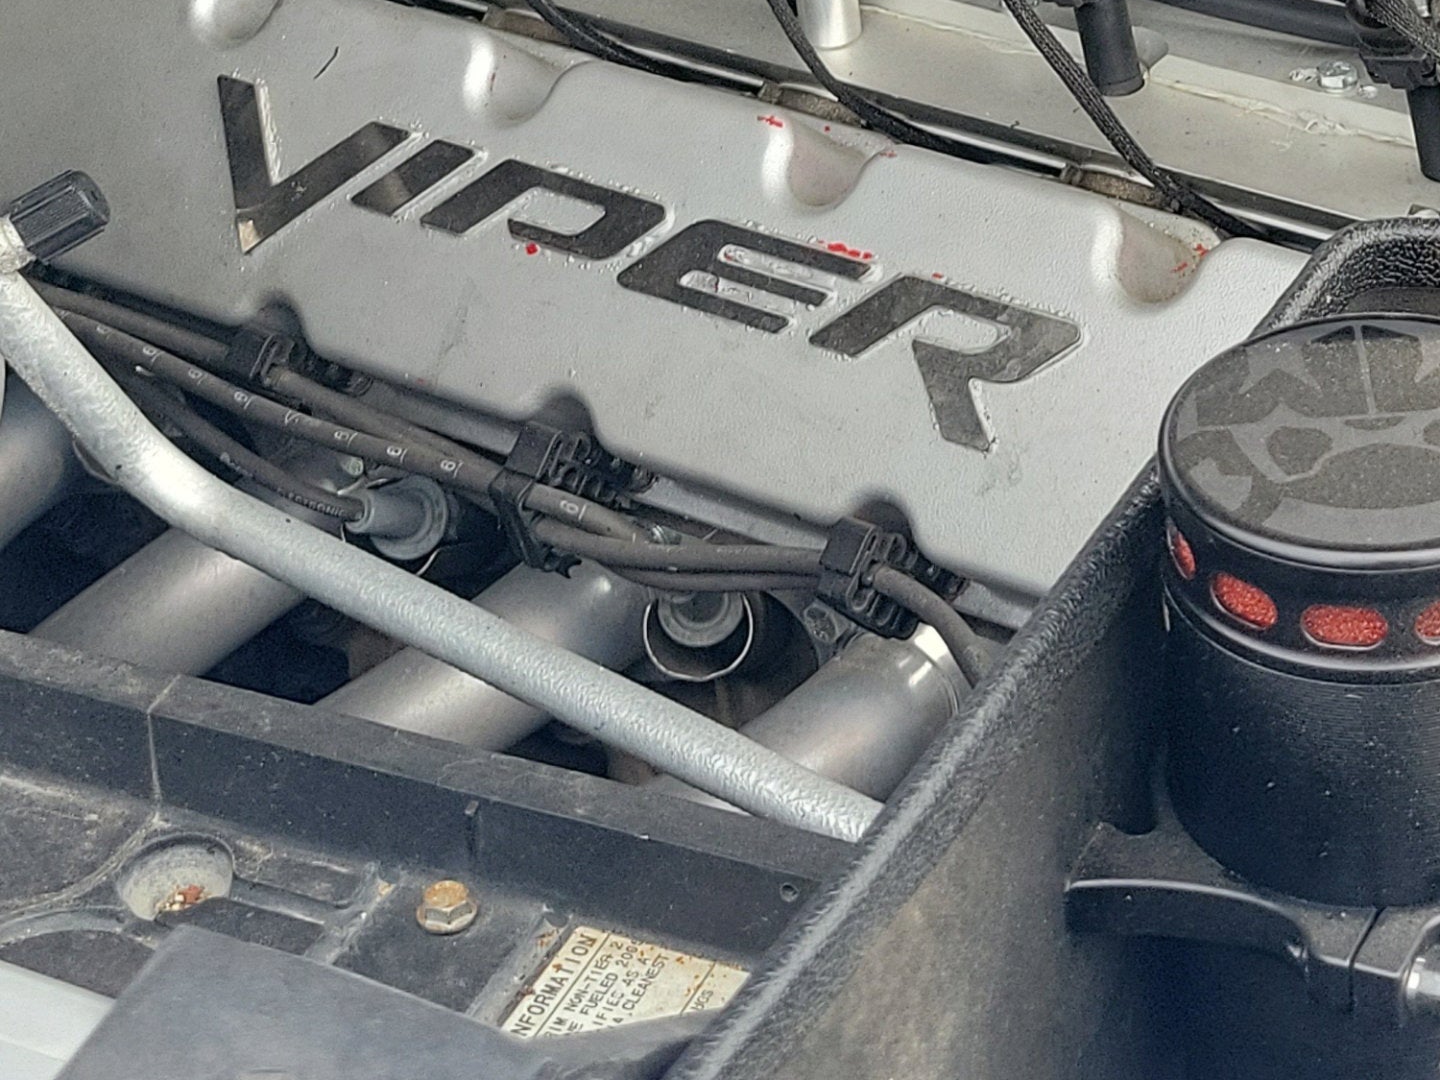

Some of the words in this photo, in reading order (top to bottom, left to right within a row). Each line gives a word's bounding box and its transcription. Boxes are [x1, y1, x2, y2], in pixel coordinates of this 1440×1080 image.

[216, 73, 1083, 453] VIPER
[609, 940, 624, 951] 2
[510, 932, 598, 1037] NFORMATION
[579, 972, 619, 1016] FUELED
[592, 991, 625, 1026] IFIES
[622, 970, 640, 988] AS
